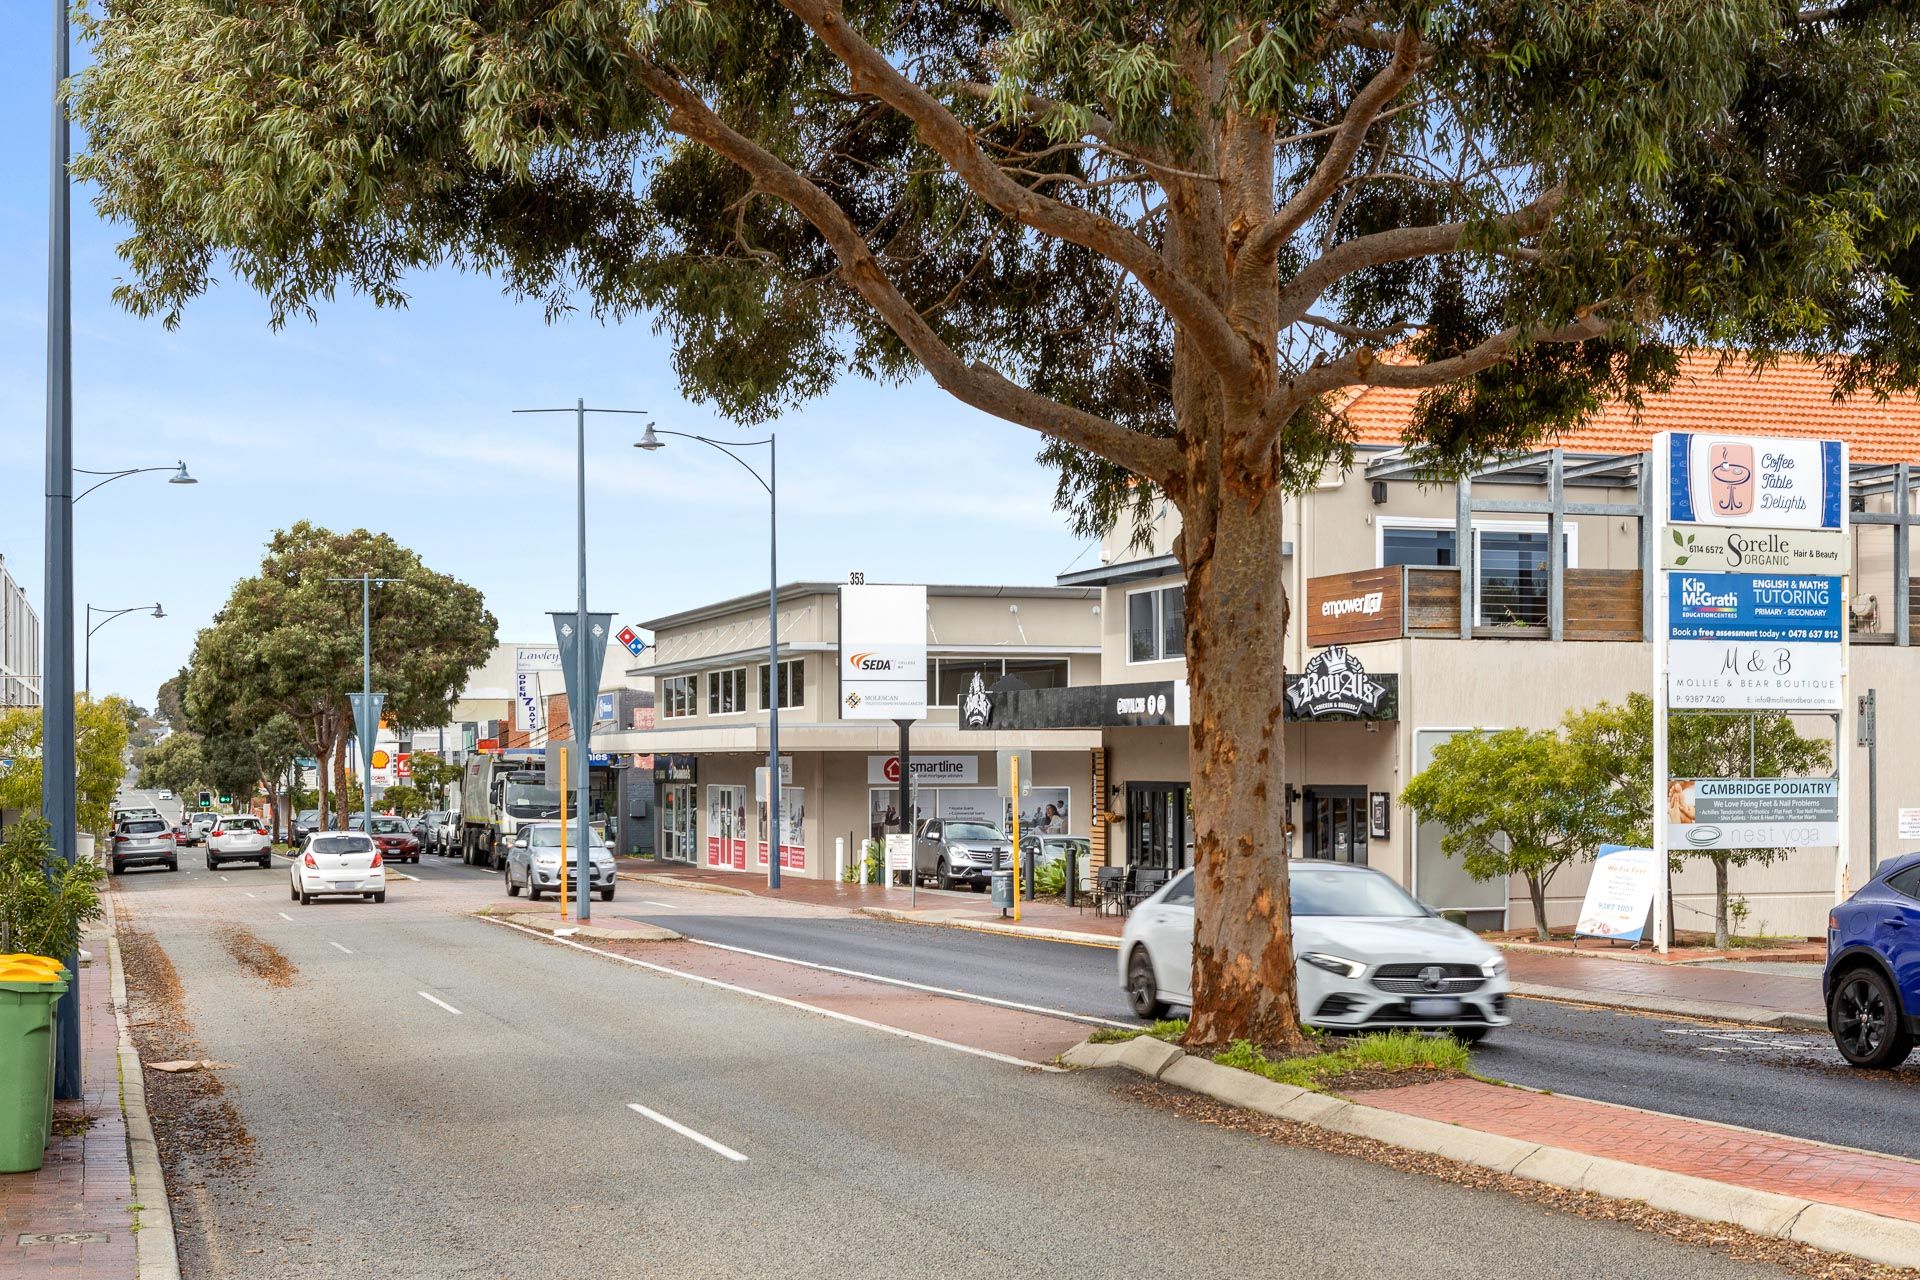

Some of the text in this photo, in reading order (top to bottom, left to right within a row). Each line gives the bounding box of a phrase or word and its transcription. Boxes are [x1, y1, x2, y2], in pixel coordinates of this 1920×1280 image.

[1761, 453, 1794, 472] Coffee
[1762, 474, 1794, 489] Table
[1760, 494, 1806, 514] Delights
[1690, 545, 1724, 554] 6114 6572
[1726, 533, 1790, 567] Sorelle
[1794, 550, 1838, 560] Hair & Beauty
[1744, 554, 1790, 566] ORGANIC
[850, 572, 864, 586] 353
[1752, 580, 1829, 590] ENGLISH & MATHS
[1682, 578, 1706, 596] Kip
[1682, 592, 1738, 606] McGrath
[1753, 590, 1829, 604] TUTORING
[1754, 608, 1782, 616] PRIMARY
[1788, 608, 1827, 617] SECONDARY
[1672, 628, 1691, 636] Book
[1698, 628, 1714, 637] free
[1759, 629, 1780, 639] today
[1788, 630, 1807, 638] 0478
[1808, 630, 1822, 638] 637
[1824, 630, 1838, 638] 812
[862, 660, 891, 670] SEDA
[1720, 646, 1792, 676] M & B
[1676, 679, 1835, 688] MOLLIE & BEAR BOUTIQUE
[522, 698, 534, 706] 7
[1685, 695, 1704, 703] 9387
[910, 760, 963, 772] smartline
[1701, 784, 1832, 794] CAMBRIDGE PODIATRY
[1740, 800, 1758, 808] Fixing
[1731, 828, 1819, 845] nest yoga
